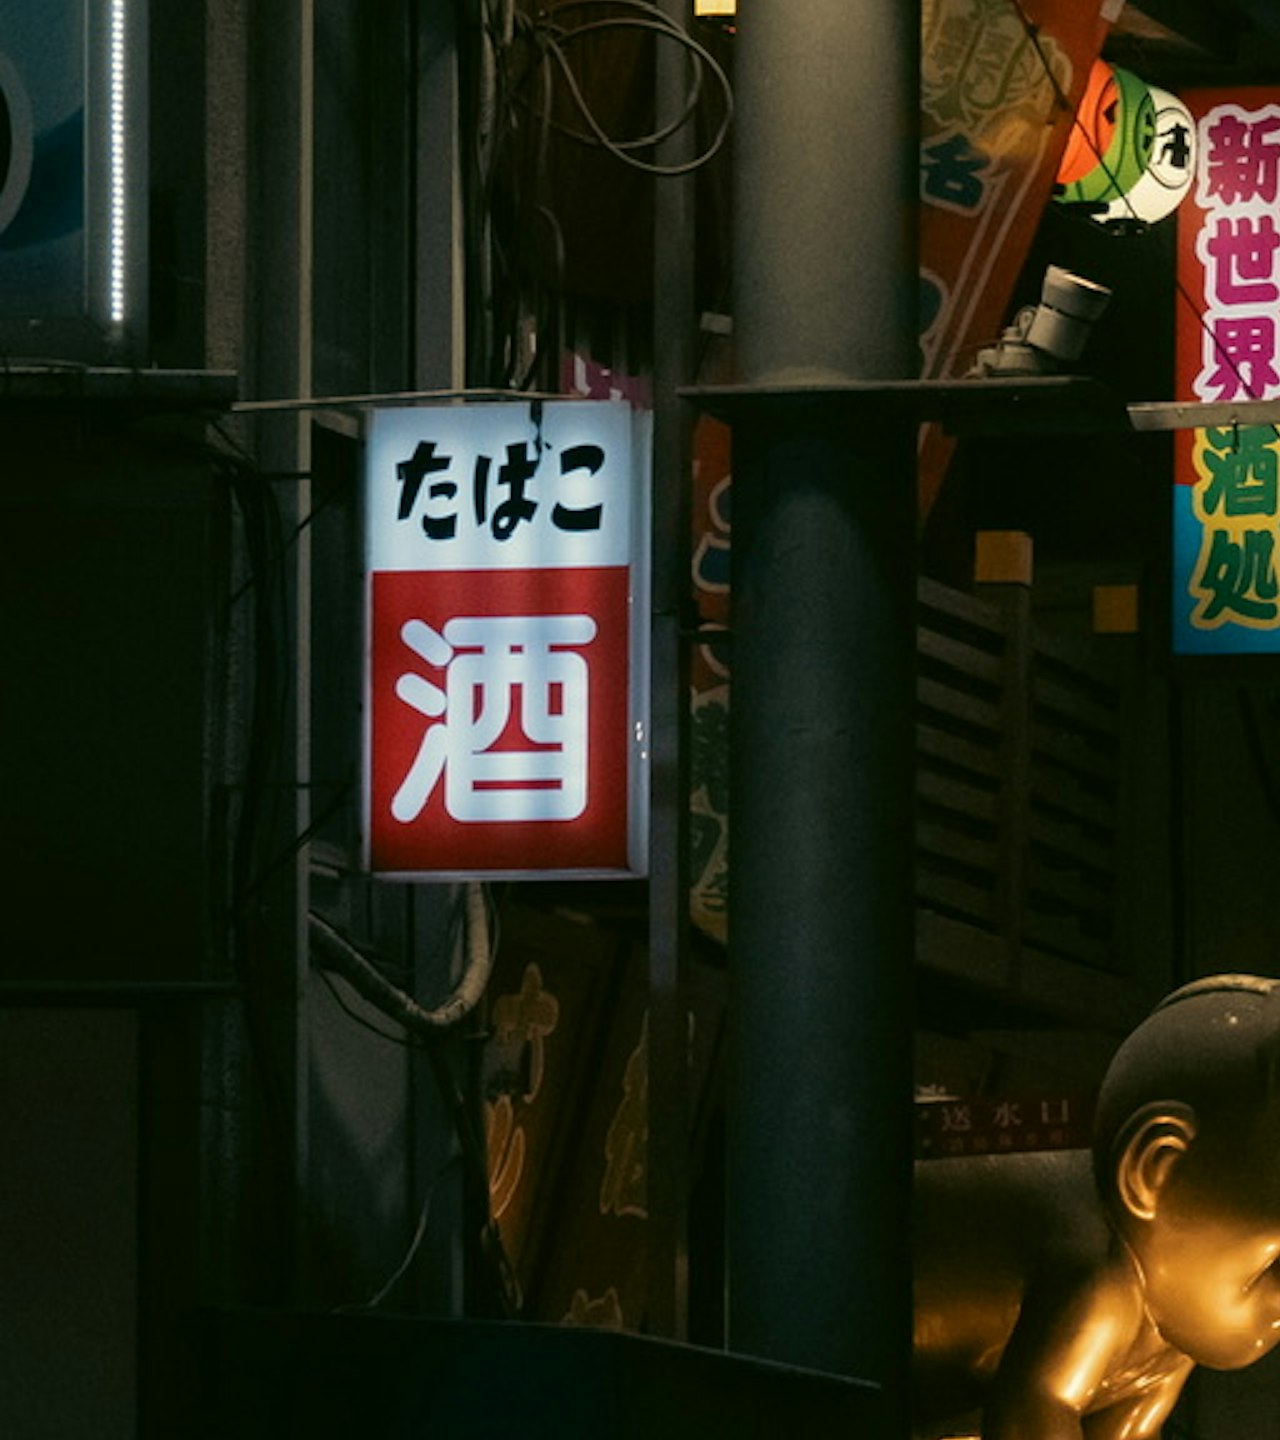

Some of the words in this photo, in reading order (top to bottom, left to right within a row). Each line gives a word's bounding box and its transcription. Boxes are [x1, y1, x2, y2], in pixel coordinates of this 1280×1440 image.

[396, 441, 605, 540] たばこ
[392, 611, 597, 824] 酒
